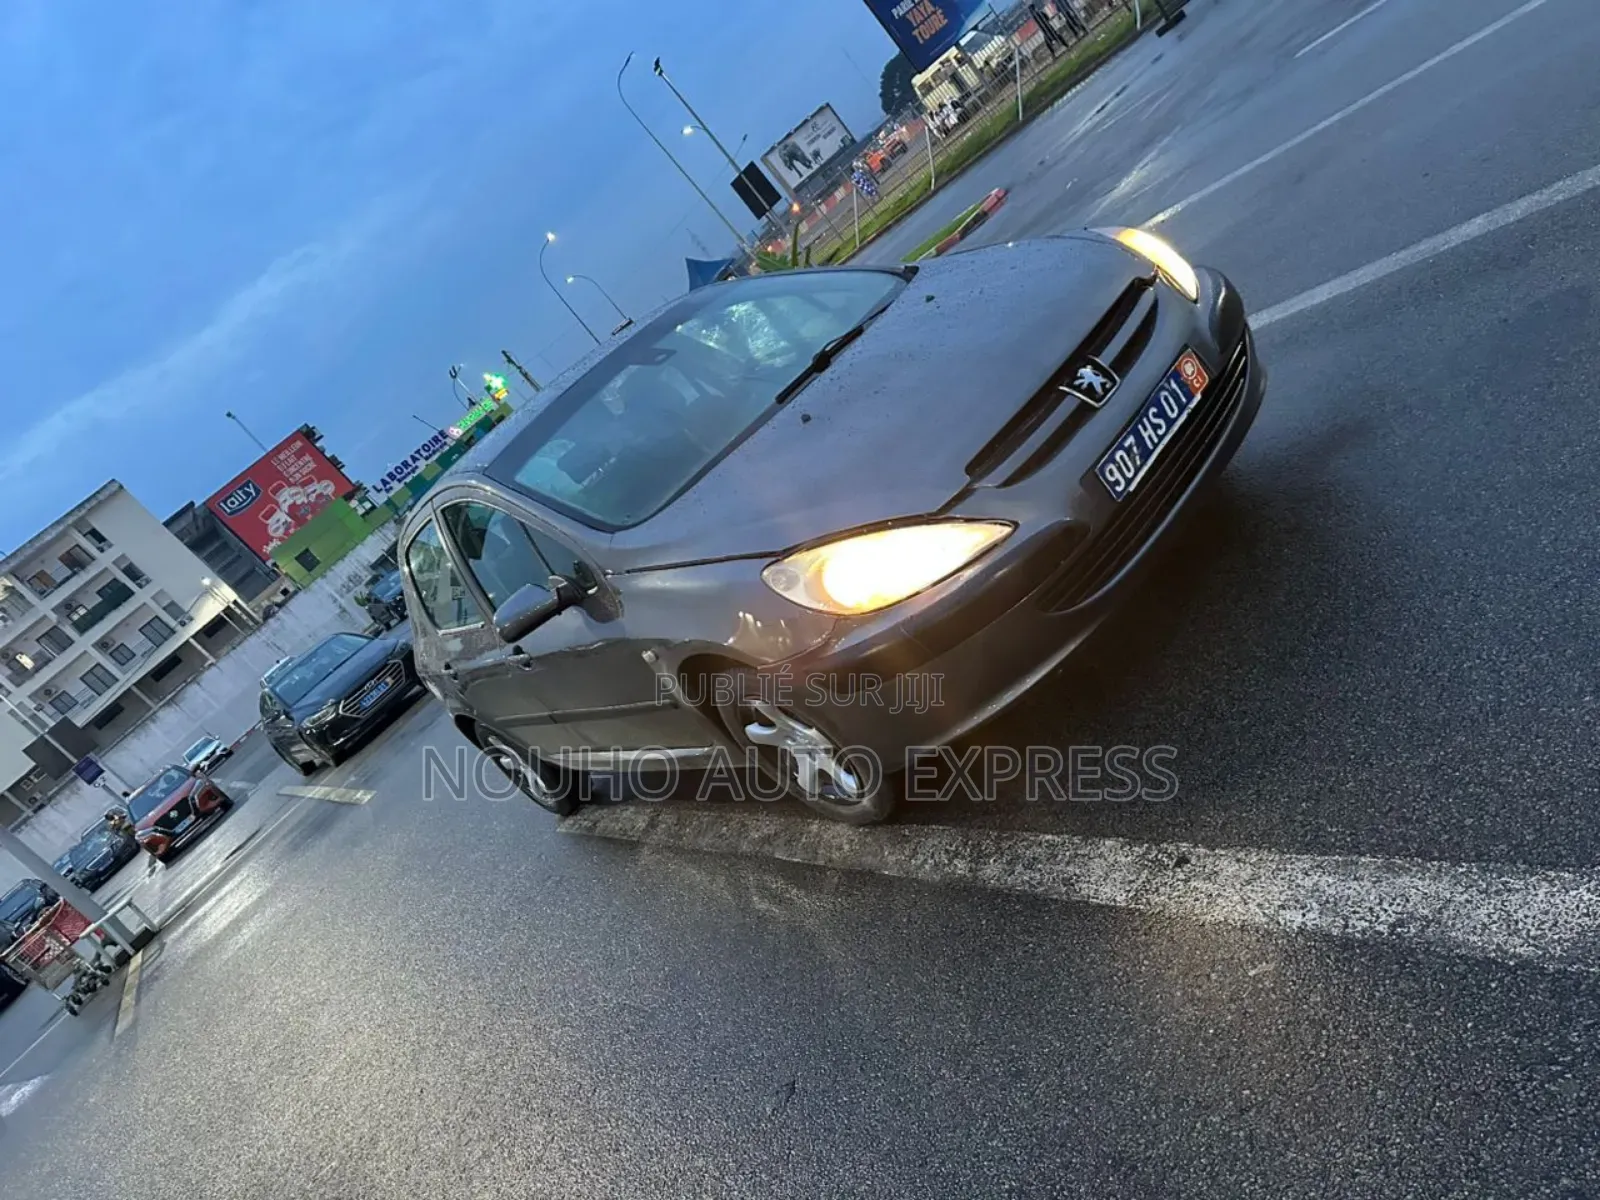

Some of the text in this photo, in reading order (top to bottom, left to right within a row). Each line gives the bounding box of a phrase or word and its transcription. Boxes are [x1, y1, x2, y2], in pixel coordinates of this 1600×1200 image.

[906, 0, 936, 27] YAYA
[372, 429, 448, 493] LABORATOIRE
[1105, 378, 1188, 492] 907 HS 01
